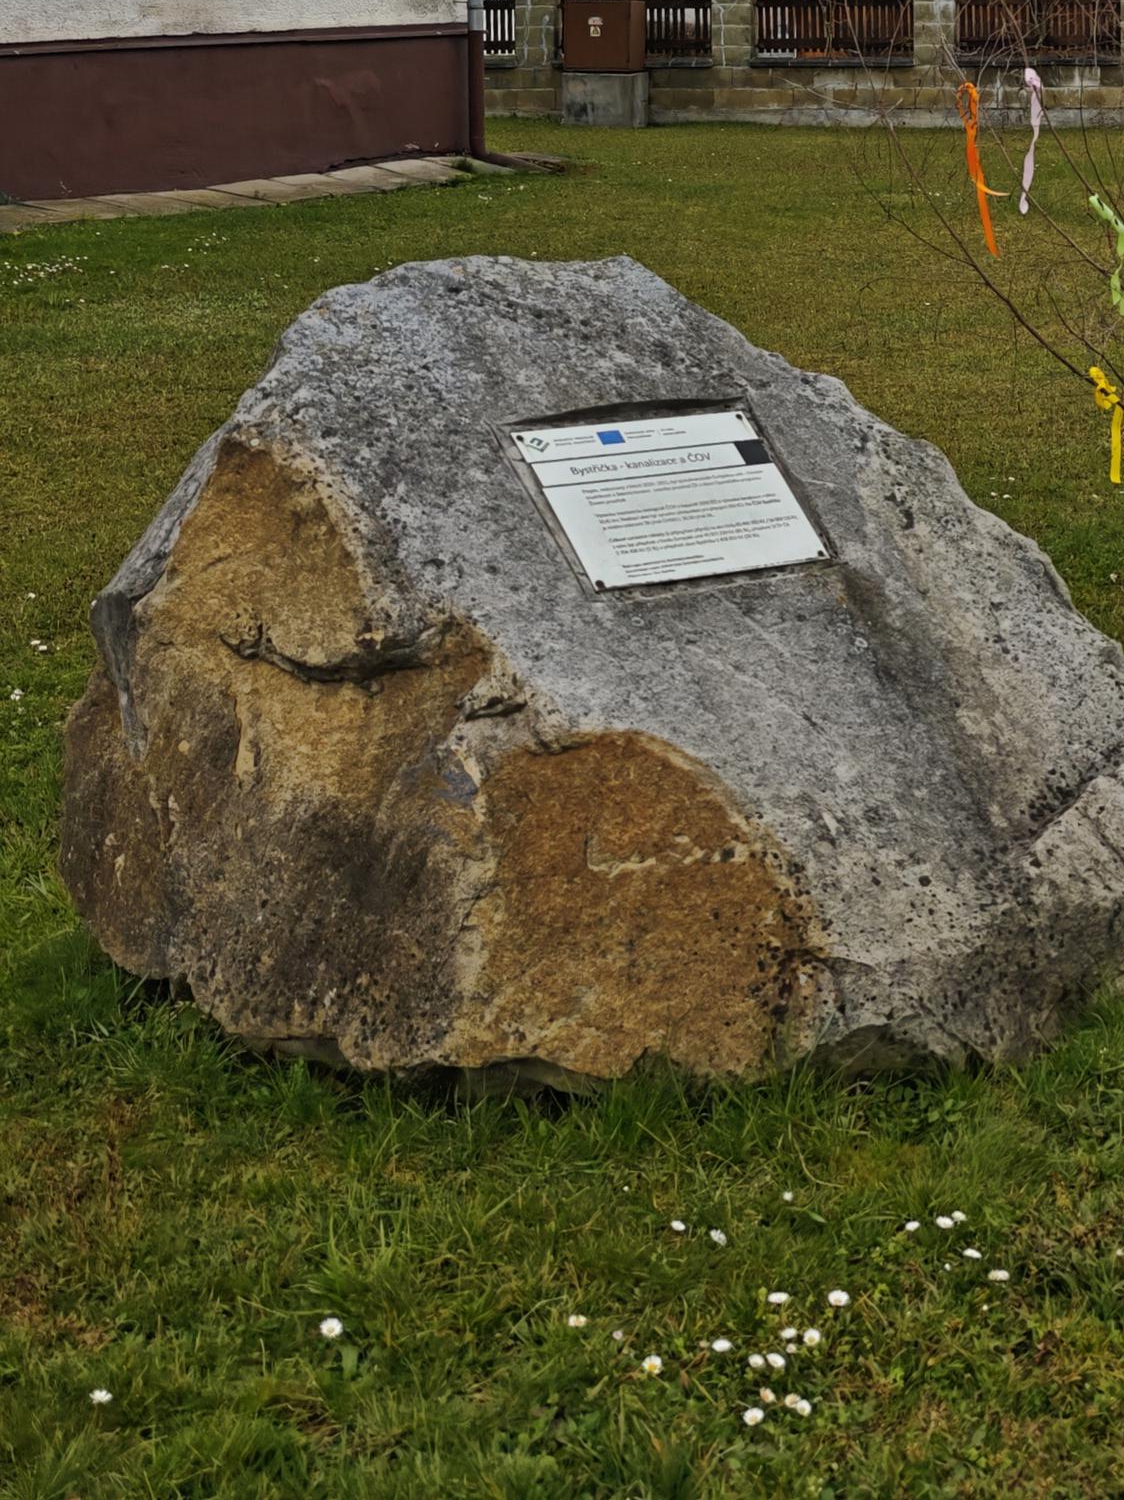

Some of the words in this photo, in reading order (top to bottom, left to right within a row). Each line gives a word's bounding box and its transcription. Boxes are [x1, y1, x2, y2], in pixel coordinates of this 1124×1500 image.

[570, 462, 618, 476] Bystřička
[625, 456, 678, 469] kanalizace
[687, 452, 711, 463] ČOV
